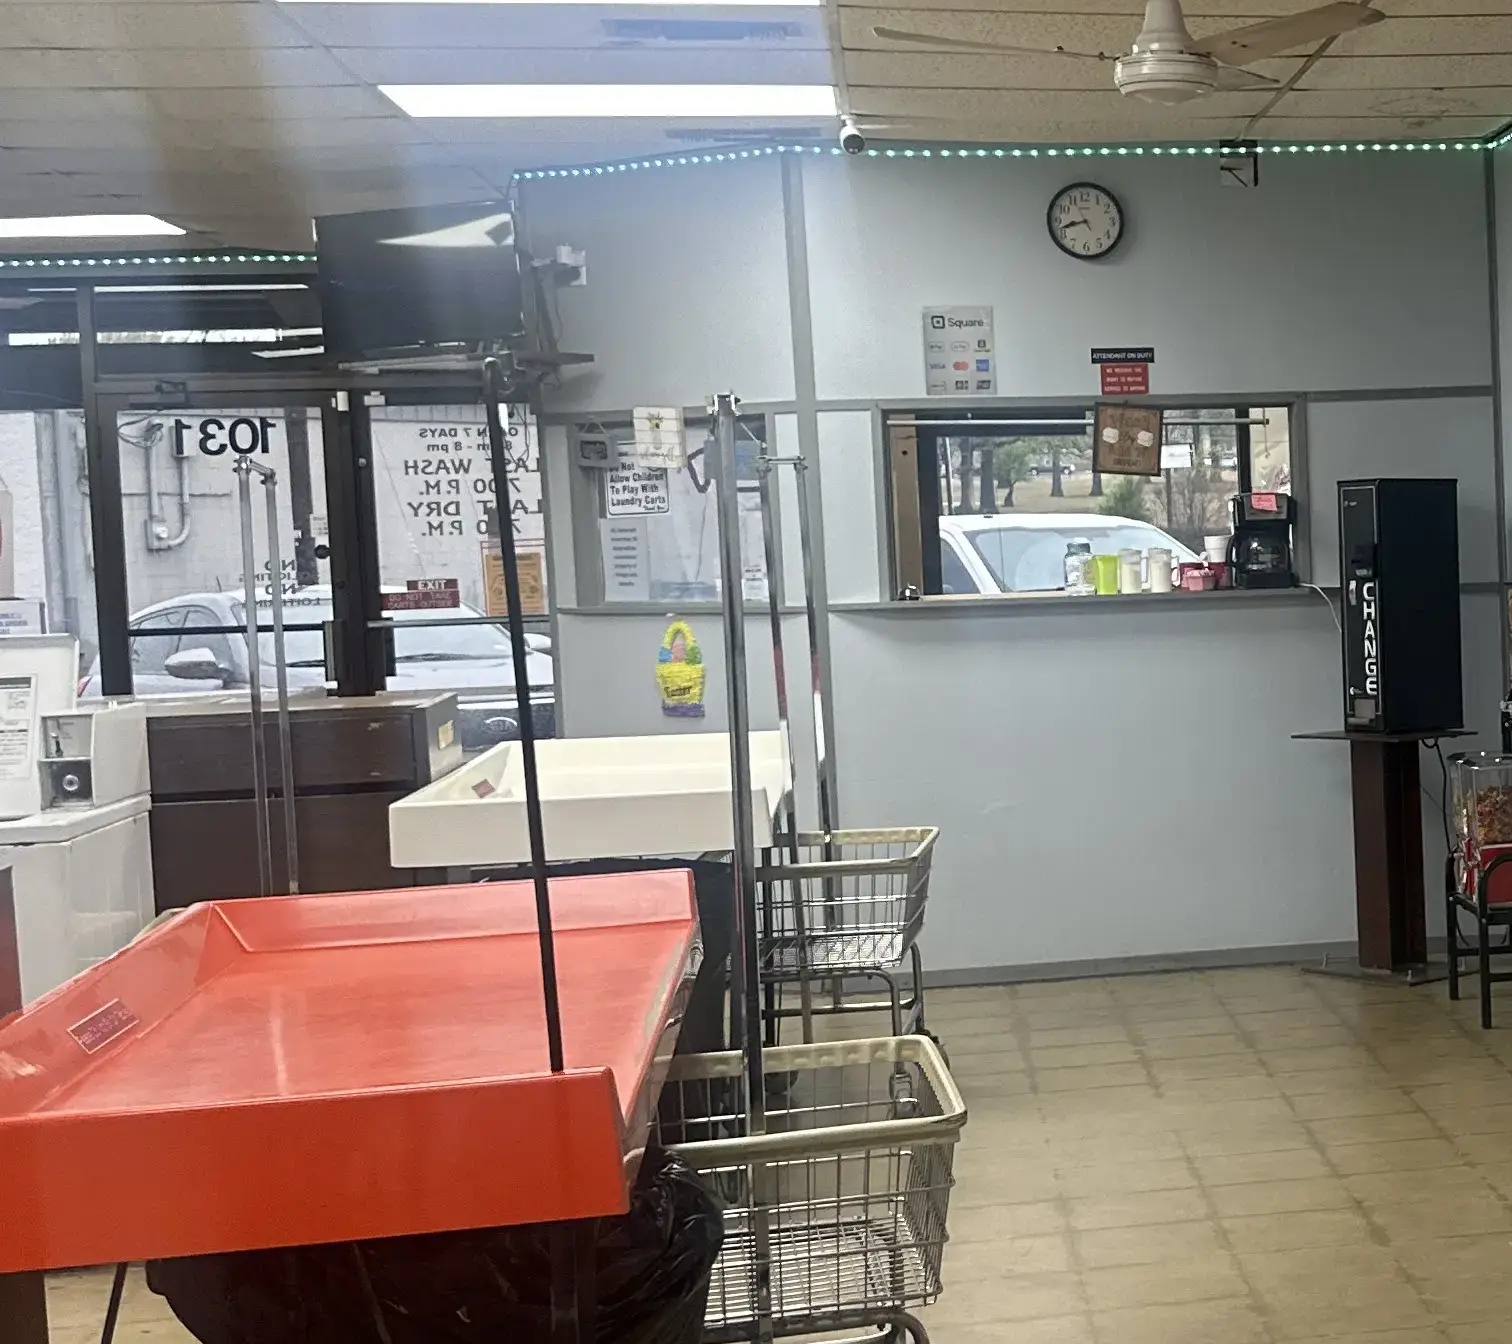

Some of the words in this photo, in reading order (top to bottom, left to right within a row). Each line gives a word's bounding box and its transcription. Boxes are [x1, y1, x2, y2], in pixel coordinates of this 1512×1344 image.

[947, 317, 984, 329] Square
[621, 461, 635, 470] Not
[610, 474, 630, 482] Allow
[633, 472, 664, 482] Children
[610, 485, 620, 495] To
[622, 485, 639, 496] Play
[641, 483, 659, 493] With
[611, 496, 642, 507] Laundry
[645, 495, 666, 504] Carts
[418, 580, 447, 590] EXIT
[1362, 582, 1377, 695] CHANGE
